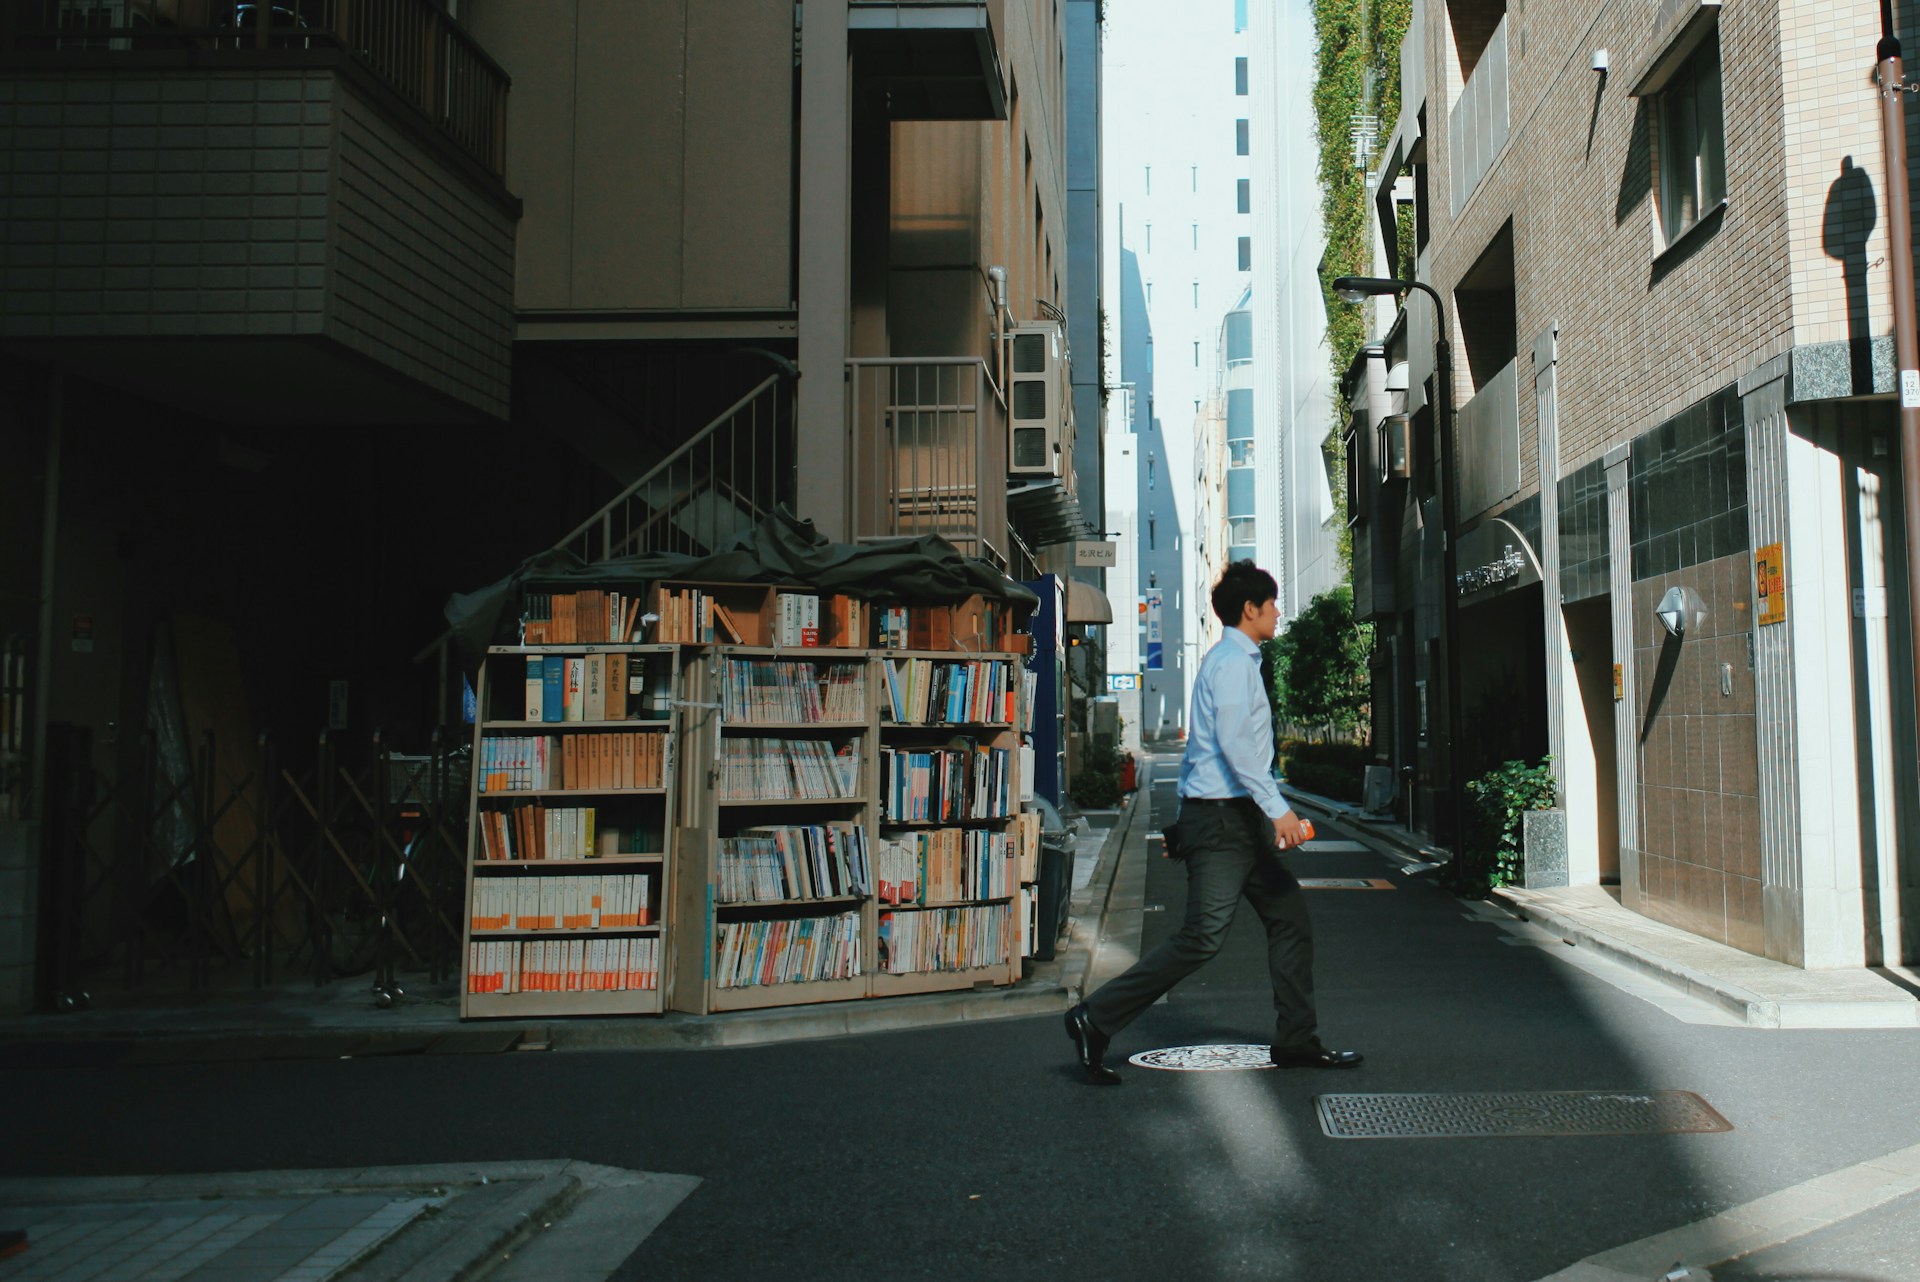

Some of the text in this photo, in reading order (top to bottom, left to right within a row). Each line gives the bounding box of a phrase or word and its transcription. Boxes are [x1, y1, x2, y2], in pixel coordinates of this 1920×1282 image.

[1079, 549, 1113, 558] 北沢ビル
[570, 661, 579, 688] 大辞林
[591, 660, 599, 695] 国語大辞典
